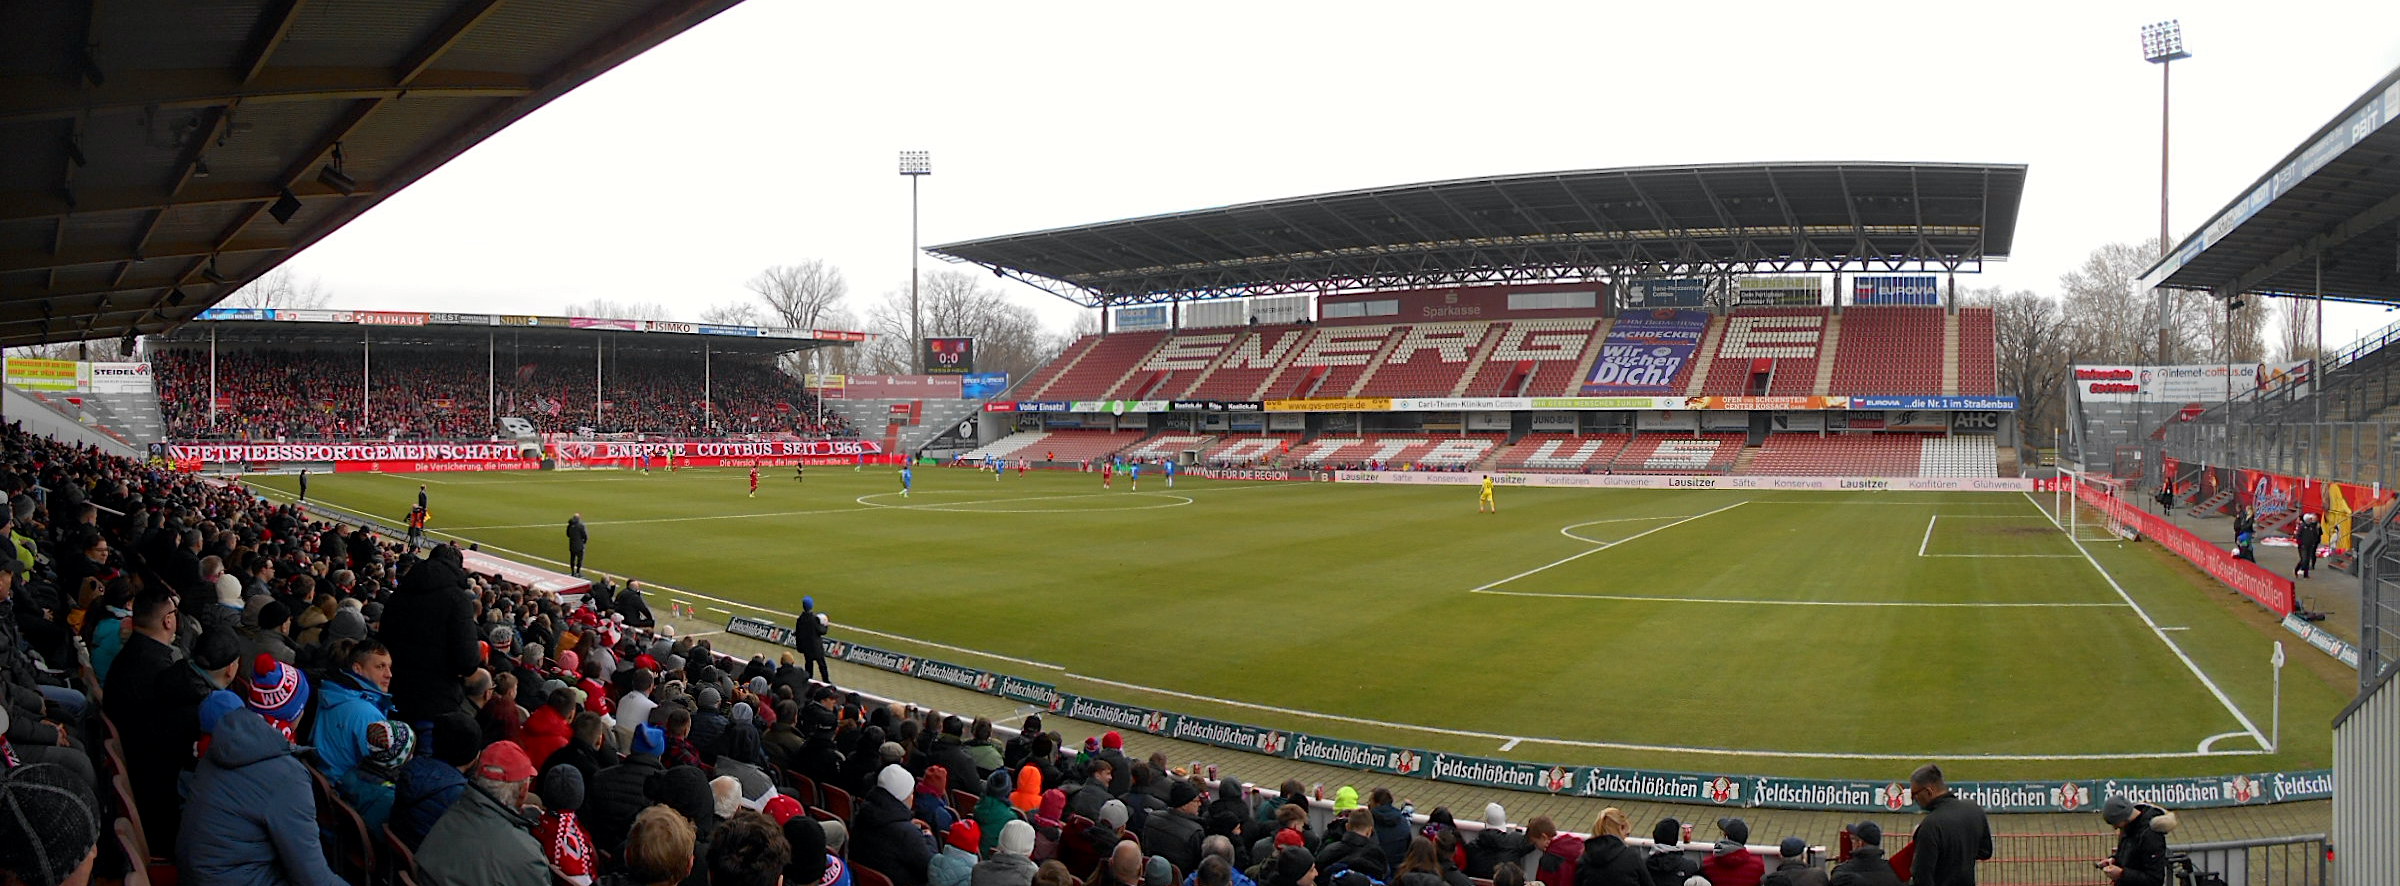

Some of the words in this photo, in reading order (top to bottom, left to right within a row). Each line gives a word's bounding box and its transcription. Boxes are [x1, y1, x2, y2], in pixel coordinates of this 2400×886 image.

[1879, 286, 1936, 295] EUROVIA
[1423, 305, 1480, 317] Sparkasse
[367, 316, 423, 325] BAUHAUS
[1603, 345, 1643, 357] Wir
[939, 353, 958, 363] 0:0
[1605, 354, 1681, 367] suchen
[1592, 362, 1676, 386] Dich!
[1019, 403, 1038, 411] Voller
[1039, 402, 1065, 411] Einsatz!
[1288, 400, 1366, 411] www.gvs-energie.de
[1928, 399, 1940, 408] Nr.
[1950, 398, 1962, 408] im
[1965, 398, 2014, 408] Straßenbau
[1954, 413, 1997, 428] AHC
[697, 442, 772, 456] COTTBUS
[783, 443, 817, 455] SEIT
[829, 442, 861, 454] 1966
[416, 463, 428, 471] Die
[430, 462, 483, 472] Versicherung,
[484, 462, 497, 470] die
[719, 459, 733, 467] Die
[1222, 470, 1237, 479] FÜR
[1240, 471, 1253, 480] DIE
[1255, 471, 1288, 480] REGION
[1490, 476, 1527, 484] ausitzer
[1669, 478, 1716, 487] Lausitzer
[1733, 479, 1757, 487] Säfte
[1775, 479, 1823, 488] Konserven
[1841, 479, 1889, 488] Lausitzer
[1910, 480, 1958, 488] Konfitüren
[1974, 480, 2021, 489] Glühweine
[919, 658, 974, 686] Feldschlößchen
[262, 688, 290, 706] WIR
[1069, 697, 1139, 727] Feldschlößchen
[1173, 715, 1255, 747] Feldschlößchen
[1295, 736, 1386, 768] Feldschlößchen
[1431, 752, 1534, 787] Feldschlößchen
[1586, 769, 1698, 798] Feldschlößchen
[2273, 773, 2332, 800] Feldschl
[1755, 777, 1870, 806] Feldschlößchen
